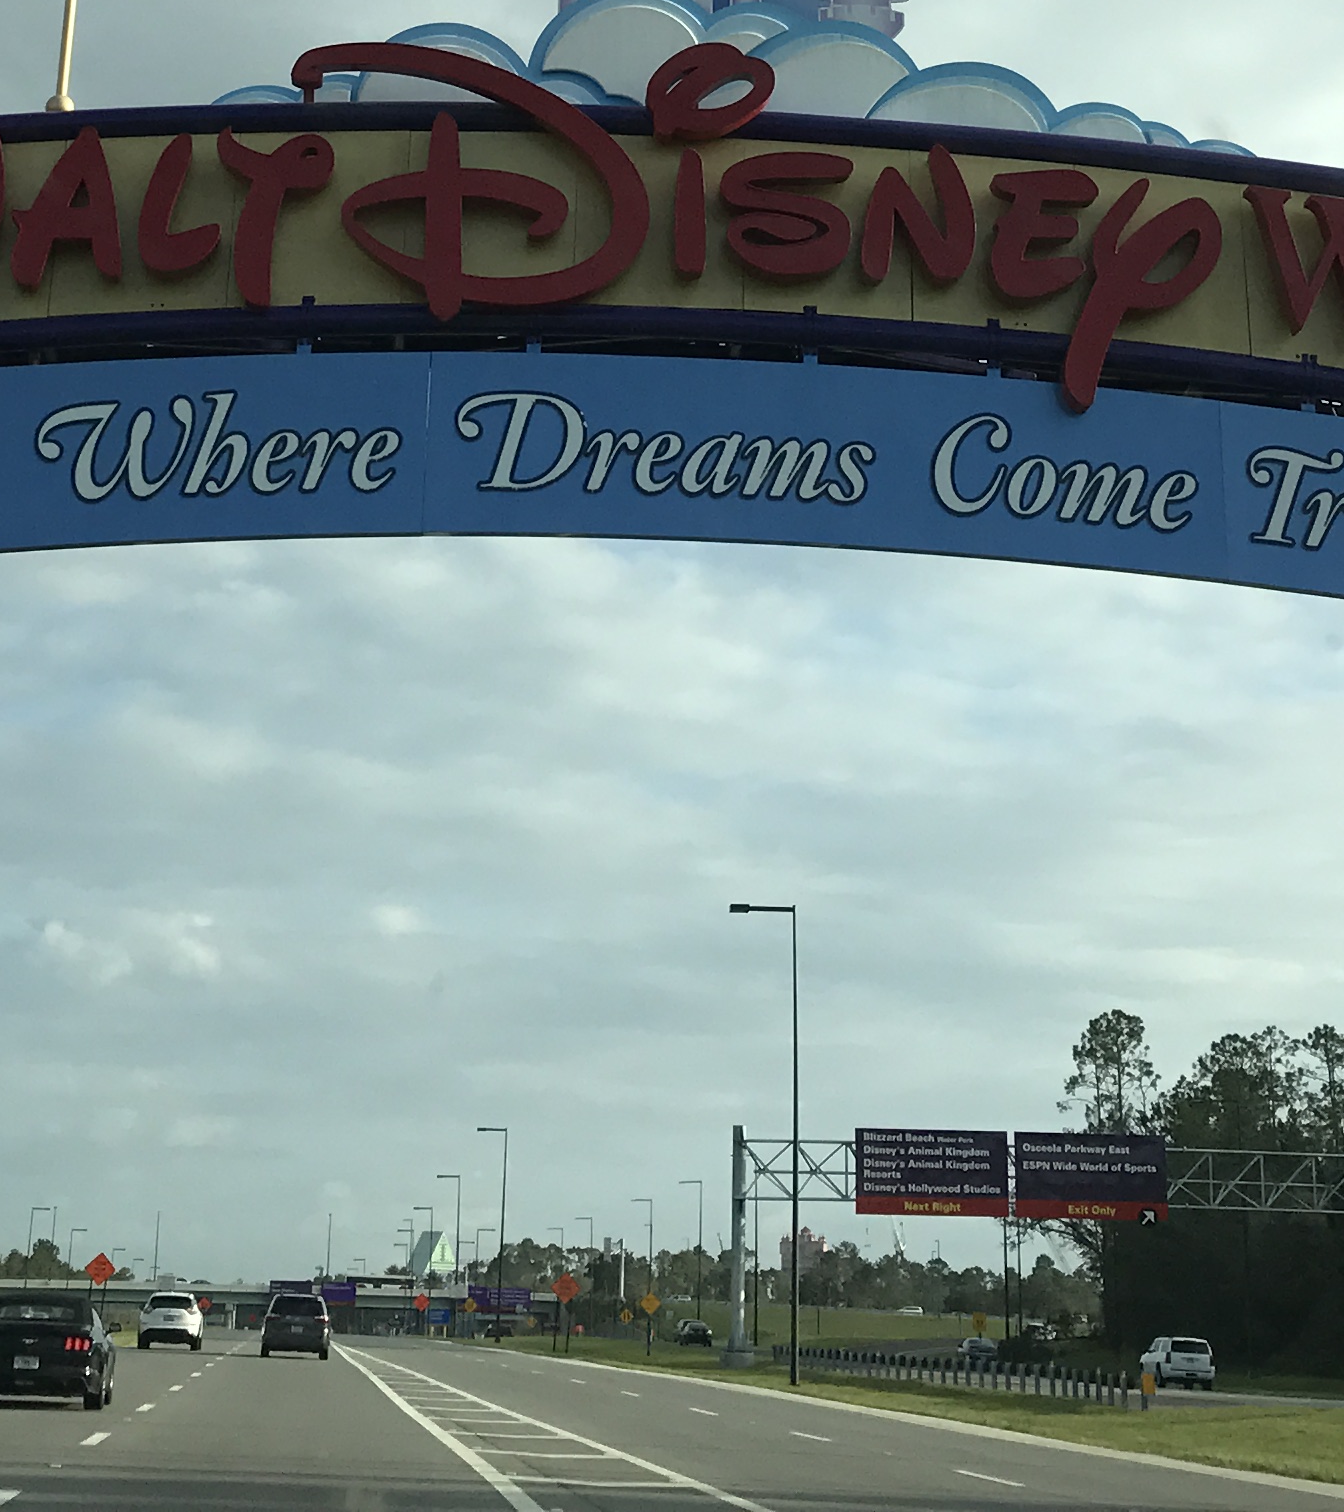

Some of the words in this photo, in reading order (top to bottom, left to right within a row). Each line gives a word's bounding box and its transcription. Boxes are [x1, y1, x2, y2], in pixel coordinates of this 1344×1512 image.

[36, 389, 403, 504] Where
[454, 389, 877, 505] Dreams
[929, 412, 1201, 535] Come
[863, 1132, 903, 1142] Blizzard
[905, 1133, 935, 1143] Beach
[863, 1145, 905, 1157] Disney's
[908, 1146, 943, 1156] Animal
[945, 1147, 990, 1158] Kingdom
[1022, 1143, 1062, 1153] Osceola
[1064, 1144, 1106, 1155] Parkway
[1108, 1145, 1130, 1155] East
[863, 1158, 906, 1169] Disney's
[908, 1159, 943, 1169] Animal
[945, 1160, 990, 1171] Kingdom
[1022, 1160, 1050, 1170] ESPN
[1052, 1161, 1077, 1171] Wide
[1079, 1162, 1108, 1172] World
[1110, 1162, 1122, 1172] of
[1124, 1163, 1157, 1173] Sports
[863, 1169, 902, 1179] Resorts
[863, 1182, 906, 1194] Disney's
[908, 1183, 961, 1194] Hollywood
[963, 1184, 1001, 1194] Studios
[904, 1201, 930, 1211] Next
[932, 1201, 961, 1212] Right
[1067, 1205, 1088, 1215] Exit
[1091, 1205, 1116, 1216] Only
